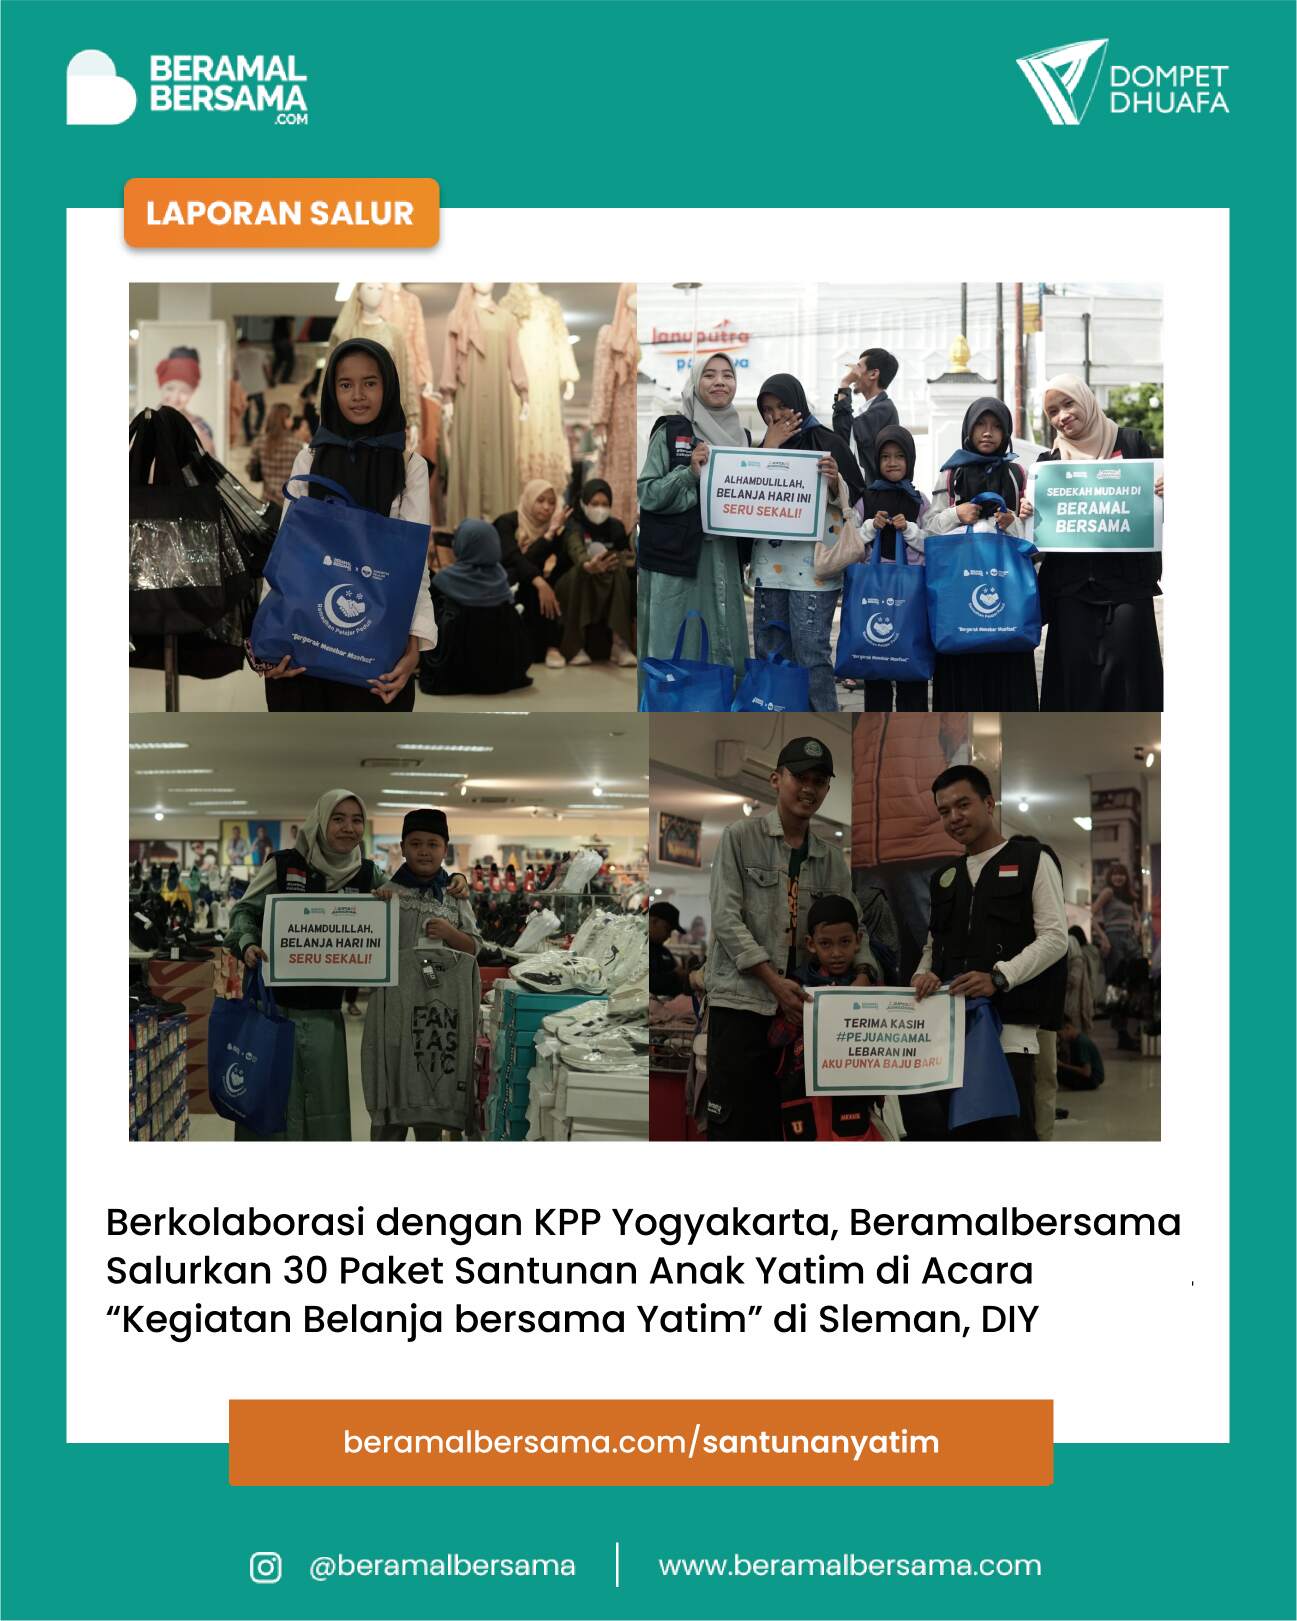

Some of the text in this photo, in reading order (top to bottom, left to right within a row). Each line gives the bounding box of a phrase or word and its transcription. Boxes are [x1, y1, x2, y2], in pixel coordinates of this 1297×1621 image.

[724, 475, 805, 489] ALHAMDULILLAH,
[716, 488, 812, 503] BELANJA HARI INI
[1047, 486, 1141, 497] SEDEKAH MUDAH DI
[723, 503, 802, 518] SERU SEKALI!
[1056, 501, 1130, 516] BERAMAL
[1056, 518, 1131, 533] BERSAMA
[288, 924, 373, 934] ALHAMDULILLAH,
[280, 938, 380, 948] BELANJA HARI INI
[288, 953, 372, 965] SERU SEKALI!
[413, 1006, 458, 1029] FAN
[844, 1018, 925, 1029] TERIMA KASIH
[413, 1029, 458, 1052] TAS
[836, 1032, 932, 1043] #PEJUANGAMAL
[848, 1047, 917, 1057] LEBARAN INI
[413, 1052, 456, 1074] TIC
[821, 1057, 942, 1069] AKU PUNYA BAJU BARU
